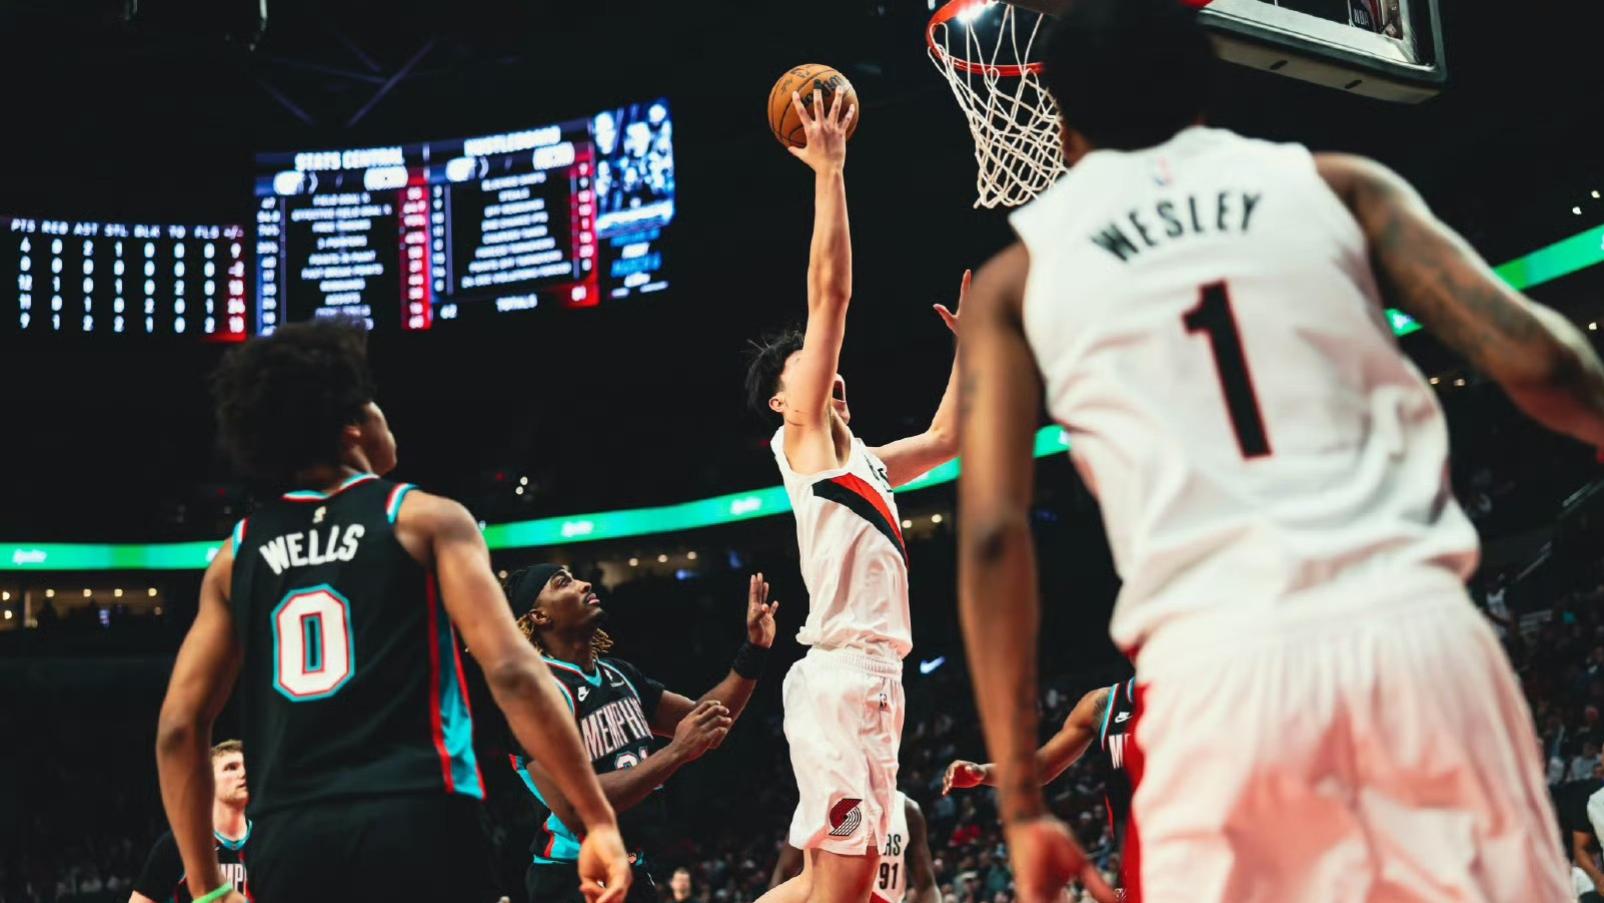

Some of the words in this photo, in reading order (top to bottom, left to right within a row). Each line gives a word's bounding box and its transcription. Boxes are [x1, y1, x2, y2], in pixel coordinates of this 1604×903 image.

[11, 218, 36, 233] PTS
[73, 222, 99, 237] AST
[104, 223, 129, 238] STL
[134, 225, 160, 239] BLK
[169, 225, 186, 239] TO
[1087, 191, 1263, 262] WESLEY
[1179, 277, 1274, 461] 1
[259, 524, 365, 576] WELLS
[270, 583, 355, 702] 0
[879, 862, 899, 890] 91
